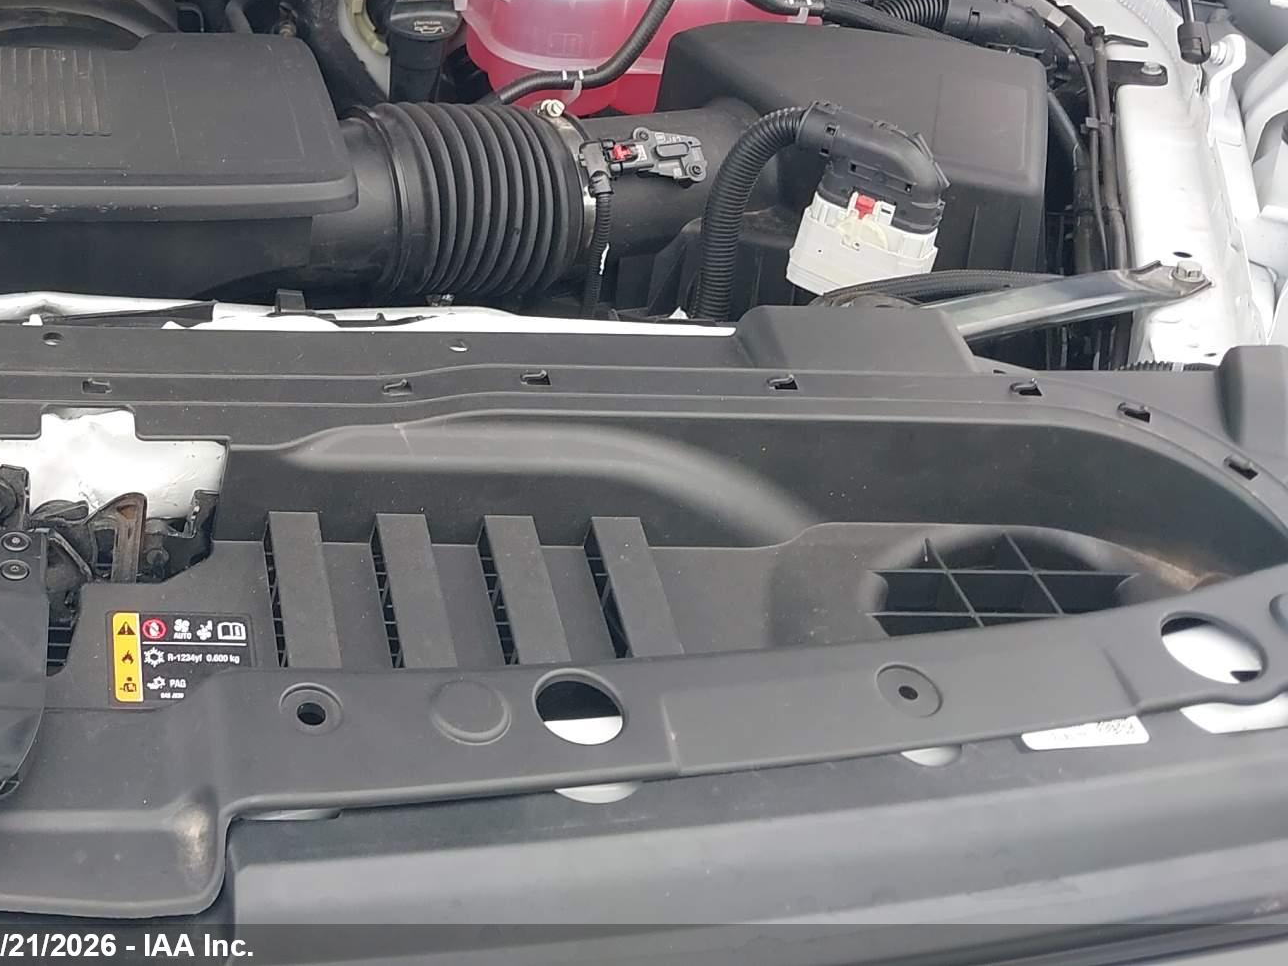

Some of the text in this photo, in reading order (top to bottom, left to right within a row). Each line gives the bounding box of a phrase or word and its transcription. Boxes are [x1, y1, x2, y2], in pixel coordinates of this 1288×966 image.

[173, 632, 193, 640] AUTO
[167, 653, 203, 664] R-1234yf
[229, 654, 240, 664] kg
[169, 678, 187, 689] PAG
